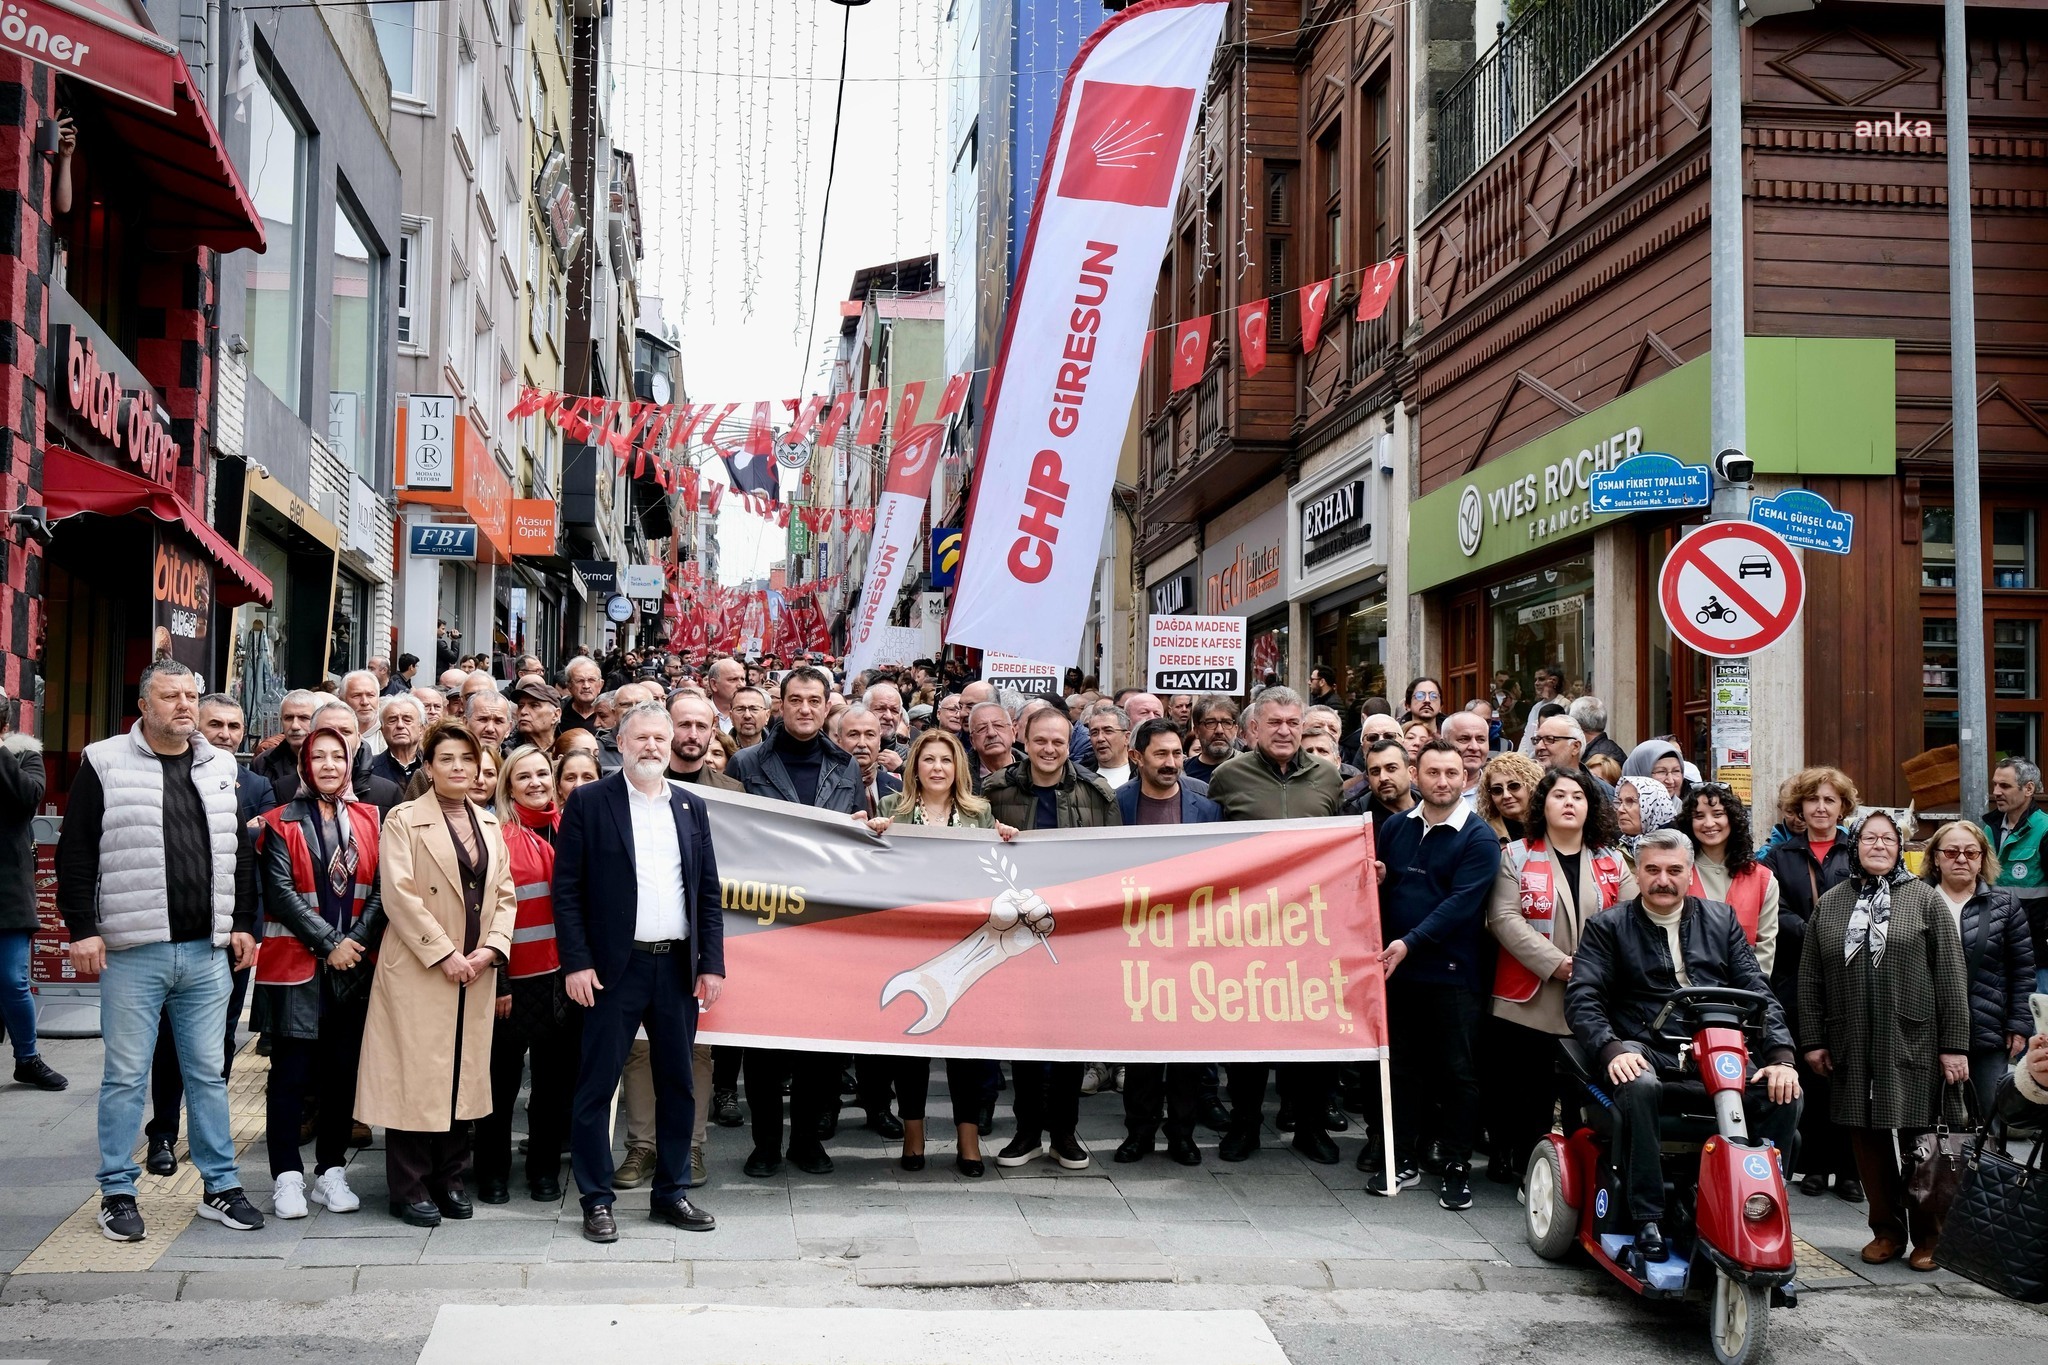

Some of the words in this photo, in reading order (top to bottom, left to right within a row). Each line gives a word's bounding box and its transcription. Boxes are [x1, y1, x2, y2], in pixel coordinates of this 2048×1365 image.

[0, 4, 90, 66] öner
[68, 324, 121, 448] bitat
[128, 389, 180, 488] döner
[1007, 449, 1070, 584] CHP
[1048, 240, 1119, 438] GİRESUN
[1488, 473, 1538, 528] YVES
[1544, 426, 1644, 505] ROCHER
[1598, 481, 1624, 491] OSMAN
[1626, 476, 1652, 488] FİKRET
[1655, 476, 1686, 487] TOPALLI
[1687, 475, 1700, 485] SK.
[1305, 481, 1356, 542] ERHAN
[1633, 498, 1649, 506] Selim
[516, 515, 552, 527] Atasun
[1529, 501, 1591, 541] FRANCE
[1758, 507, 1788, 521] CEMAL
[1790, 511, 1824, 528] GÜRSEL
[1826, 519, 1846, 532] CAD.
[417, 528, 468, 546] FBI
[519, 527, 547, 538] Optik
[1775, 531, 1814, 544] keramettin
[1815, 538, 1831, 548] Mah.
[155, 543, 199, 610] bitat
[579, 570, 613, 581] ormar
[1207, 542, 1246, 616] medi
[1246, 537, 1280, 582] bijuteri
[860, 544, 899, 643] GİRESUN
[171, 608, 197, 638] BURGER
[1156, 618, 1192, 632] DAĞDA
[1195, 621, 1240, 632] MADENE
[1153, 634, 1198, 648] DENİZDE
[1201, 637, 1242, 649] KAFESE
[991, 662, 1027, 674] DEREDE
[1160, 654, 1201, 666] DEREDE
[993, 679, 1051, 694] HAYIR!
[1162, 672, 1231, 689] HAYIR!
[1187, 884, 1331, 948] Adalet
[1120, 960, 1177, 1022] Ya
